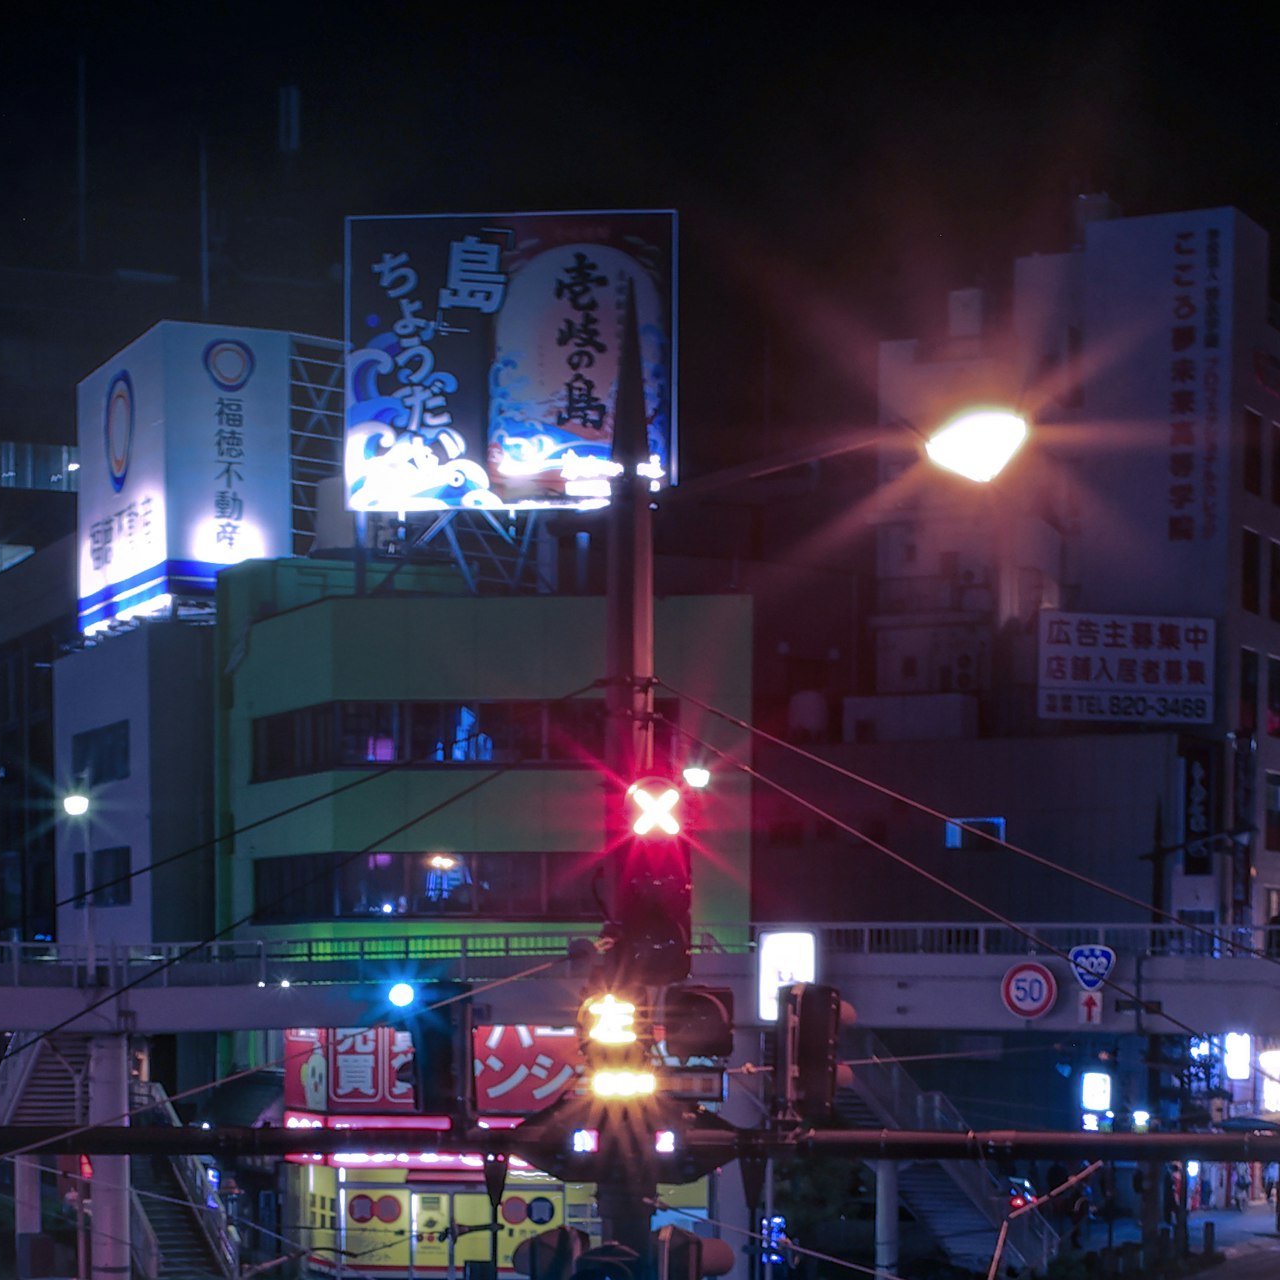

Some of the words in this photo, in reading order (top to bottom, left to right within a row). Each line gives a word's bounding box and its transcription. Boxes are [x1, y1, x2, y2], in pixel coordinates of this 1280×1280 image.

[1046, 618, 1208, 651] 広告主募集中
[1076, 695, 1106, 715] TEL
[1014, 978, 1043, 1003] 50
